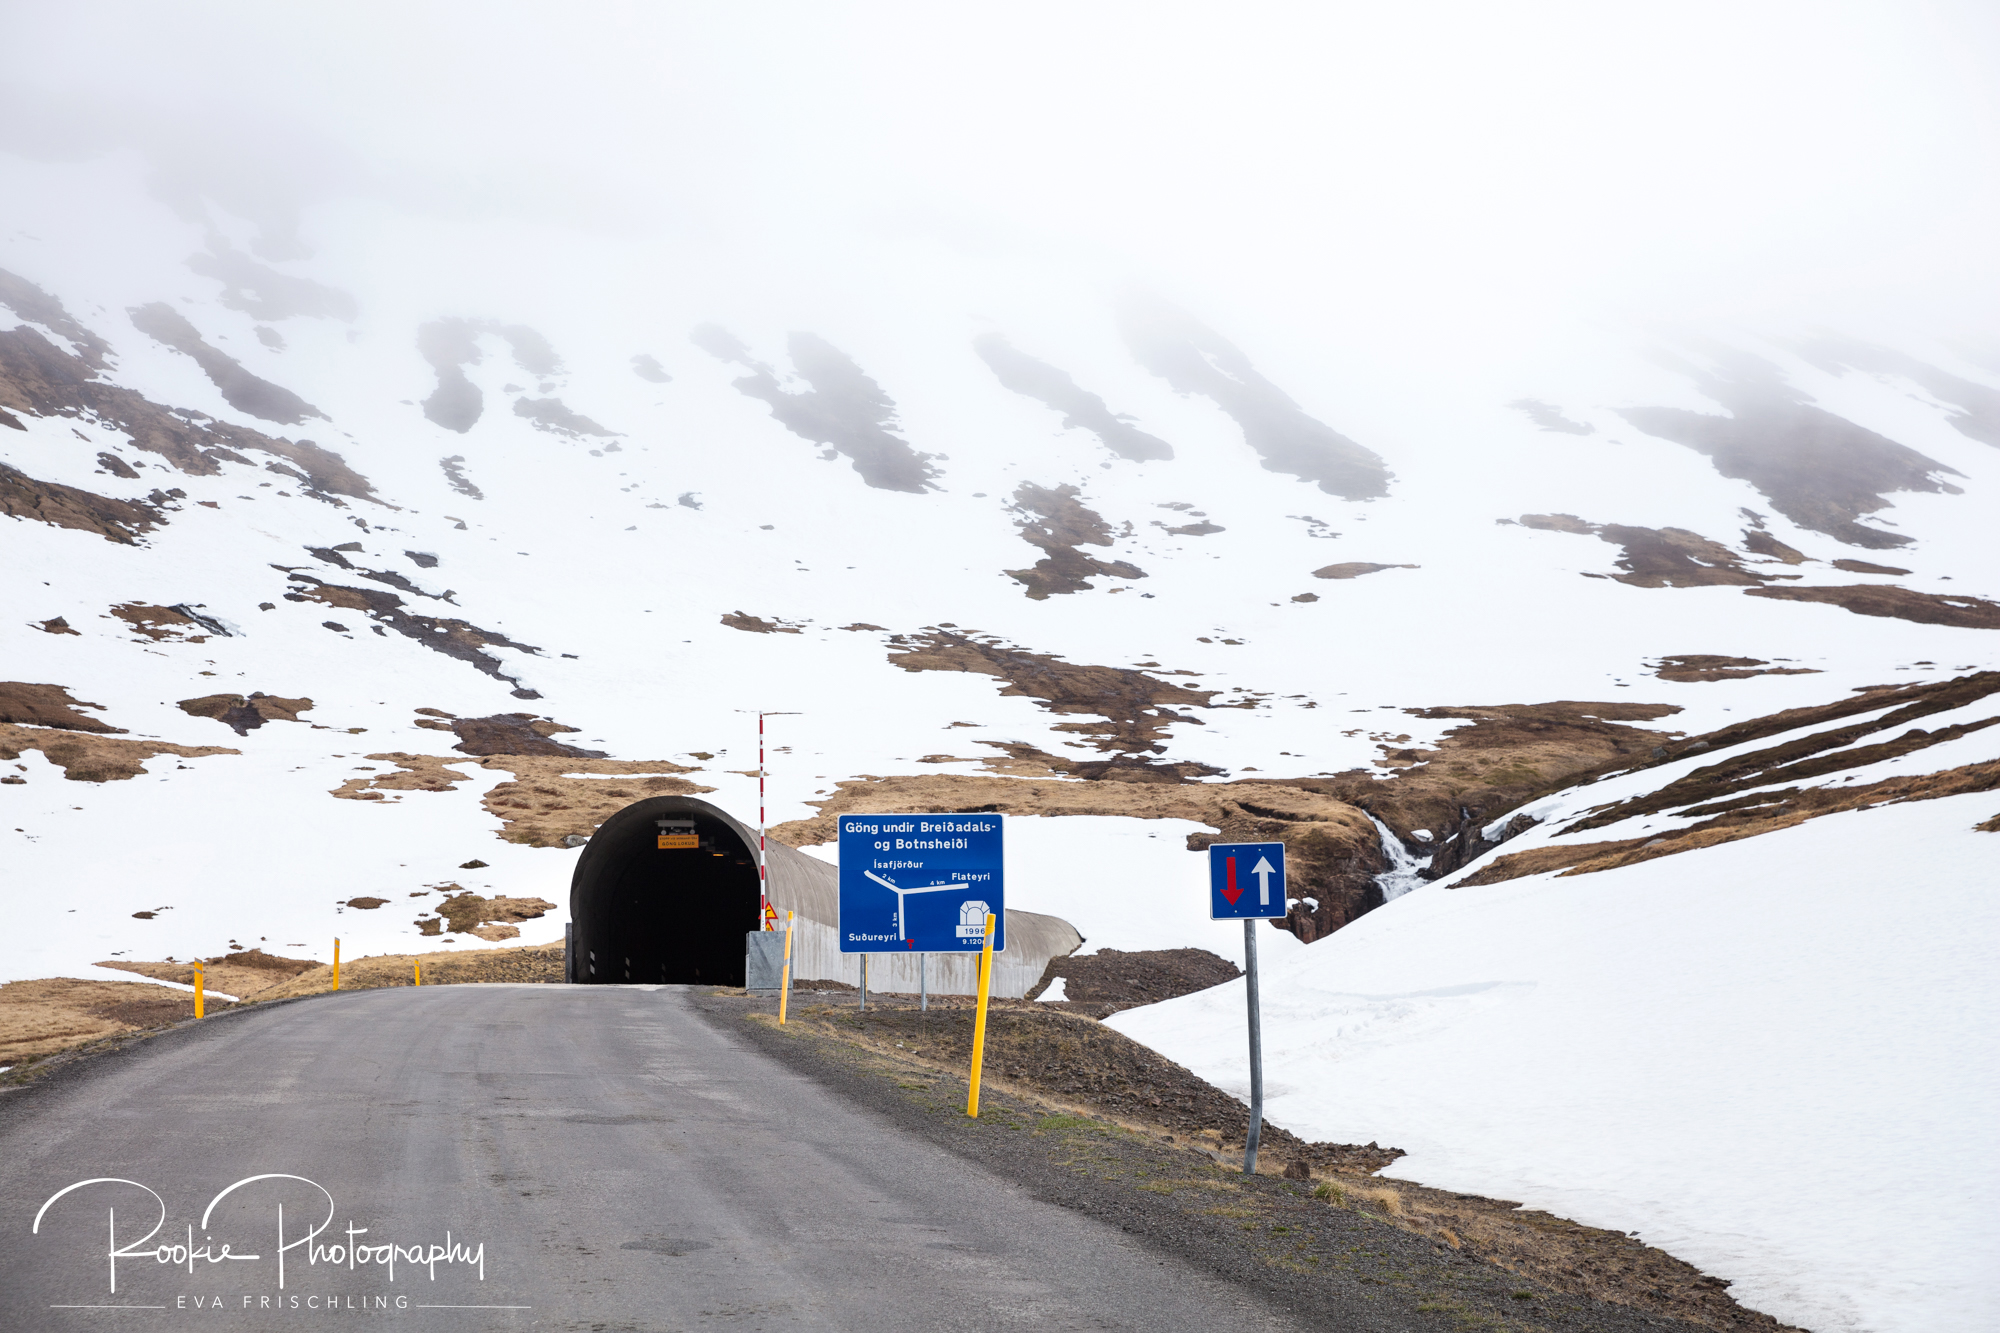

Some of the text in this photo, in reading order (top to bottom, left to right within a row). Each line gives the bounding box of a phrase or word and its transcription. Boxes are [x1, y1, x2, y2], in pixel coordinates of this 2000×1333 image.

[845, 822, 996, 834] Göng undir Breiðadals-
[874, 838, 968, 851] og Botnsheiði
[874, 859, 923, 870] Ísafjörður
[887, 875, 896, 884] km
[952, 872, 990, 881] Flateyri
[892, 912, 897, 921] km
[849, 933, 896, 942] Suðureyri
